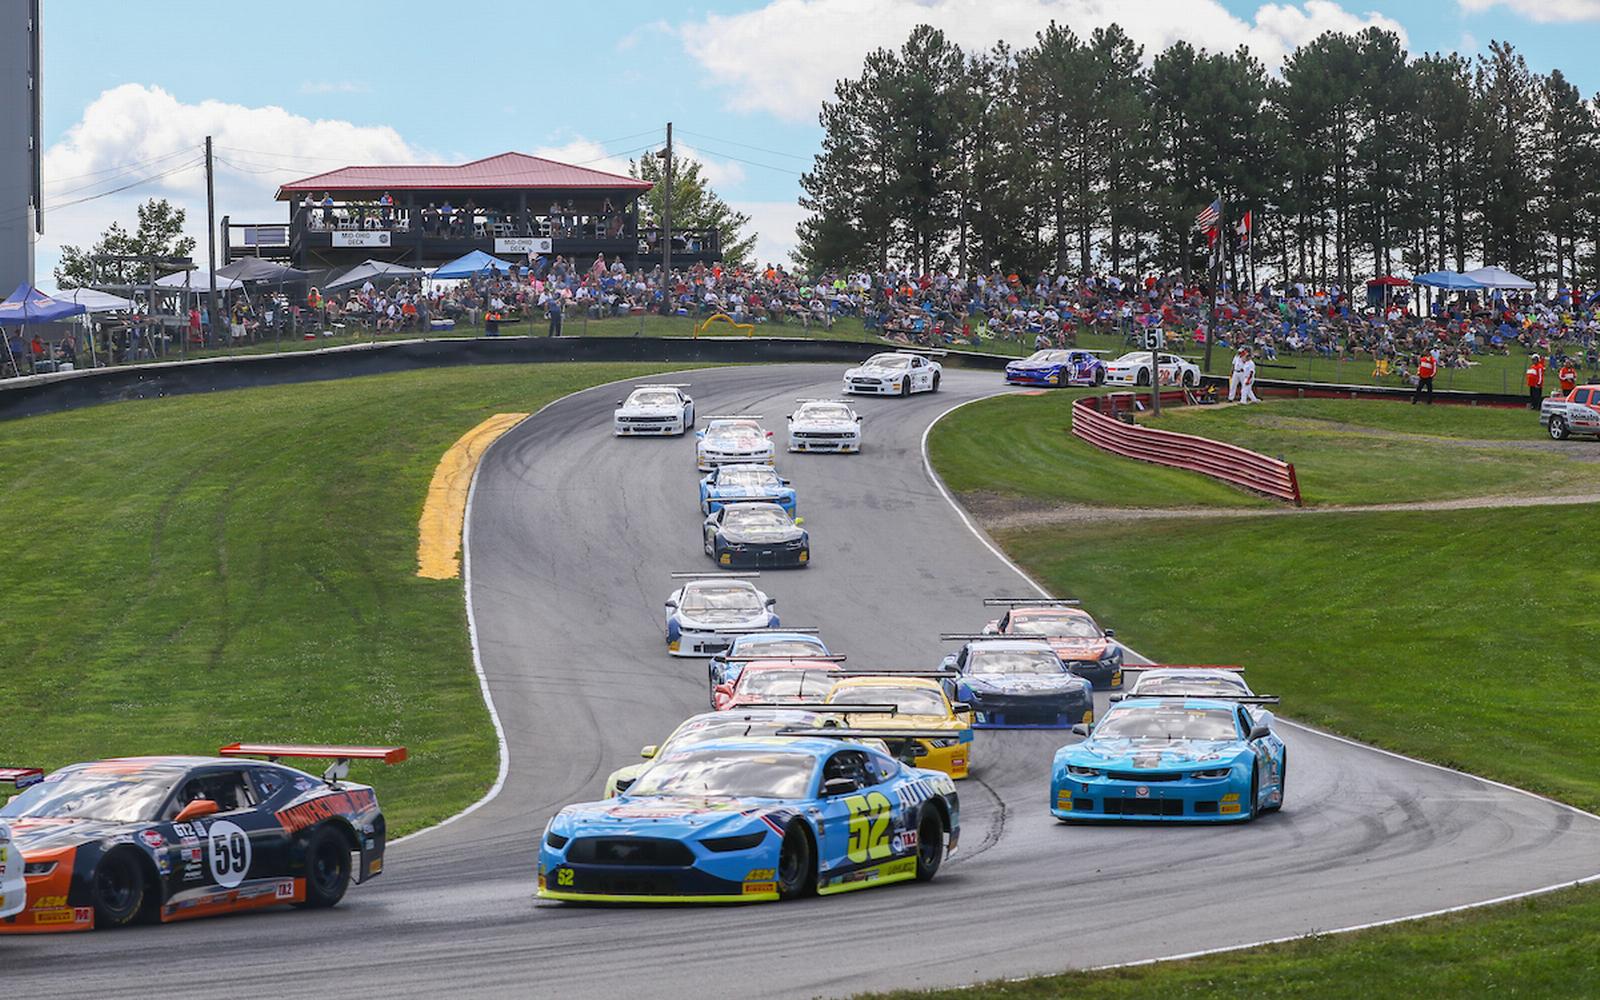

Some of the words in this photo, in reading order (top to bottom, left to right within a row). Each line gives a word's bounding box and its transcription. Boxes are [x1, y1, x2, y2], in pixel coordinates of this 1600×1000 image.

[1147, 329, 1157, 348] 5
[844, 791, 893, 864] 52
[213, 831, 247, 876] 59
[557, 868, 574, 886] 52
